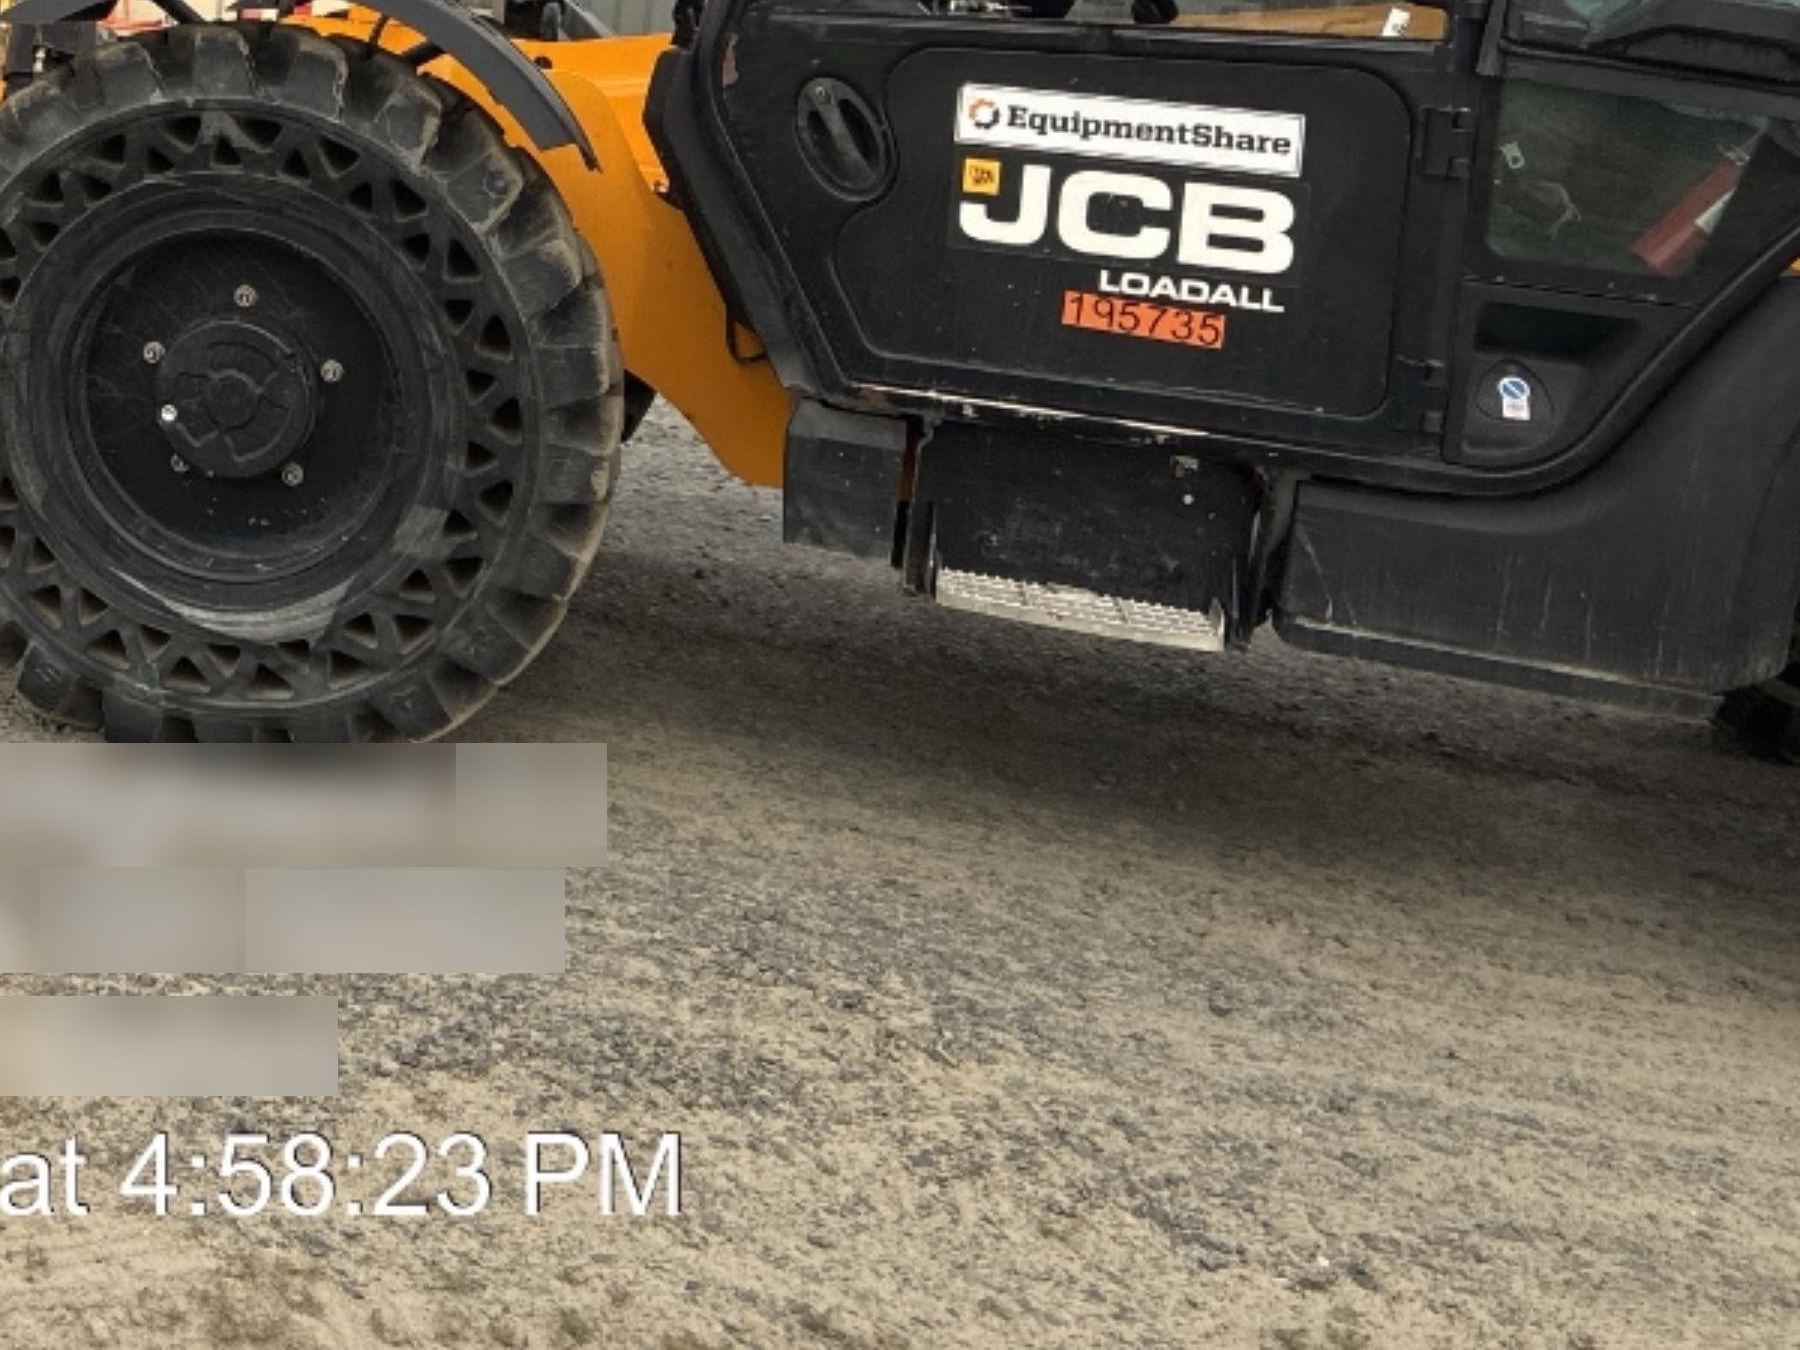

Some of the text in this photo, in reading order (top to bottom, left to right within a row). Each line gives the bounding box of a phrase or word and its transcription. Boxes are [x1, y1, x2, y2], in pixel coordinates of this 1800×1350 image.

[1006, 104, 1292, 156] EquipmentShare
[958, 163, 1296, 275] JCB
[1099, 269, 1286, 313] LOADALL
[1068, 294, 1223, 347] 195735
